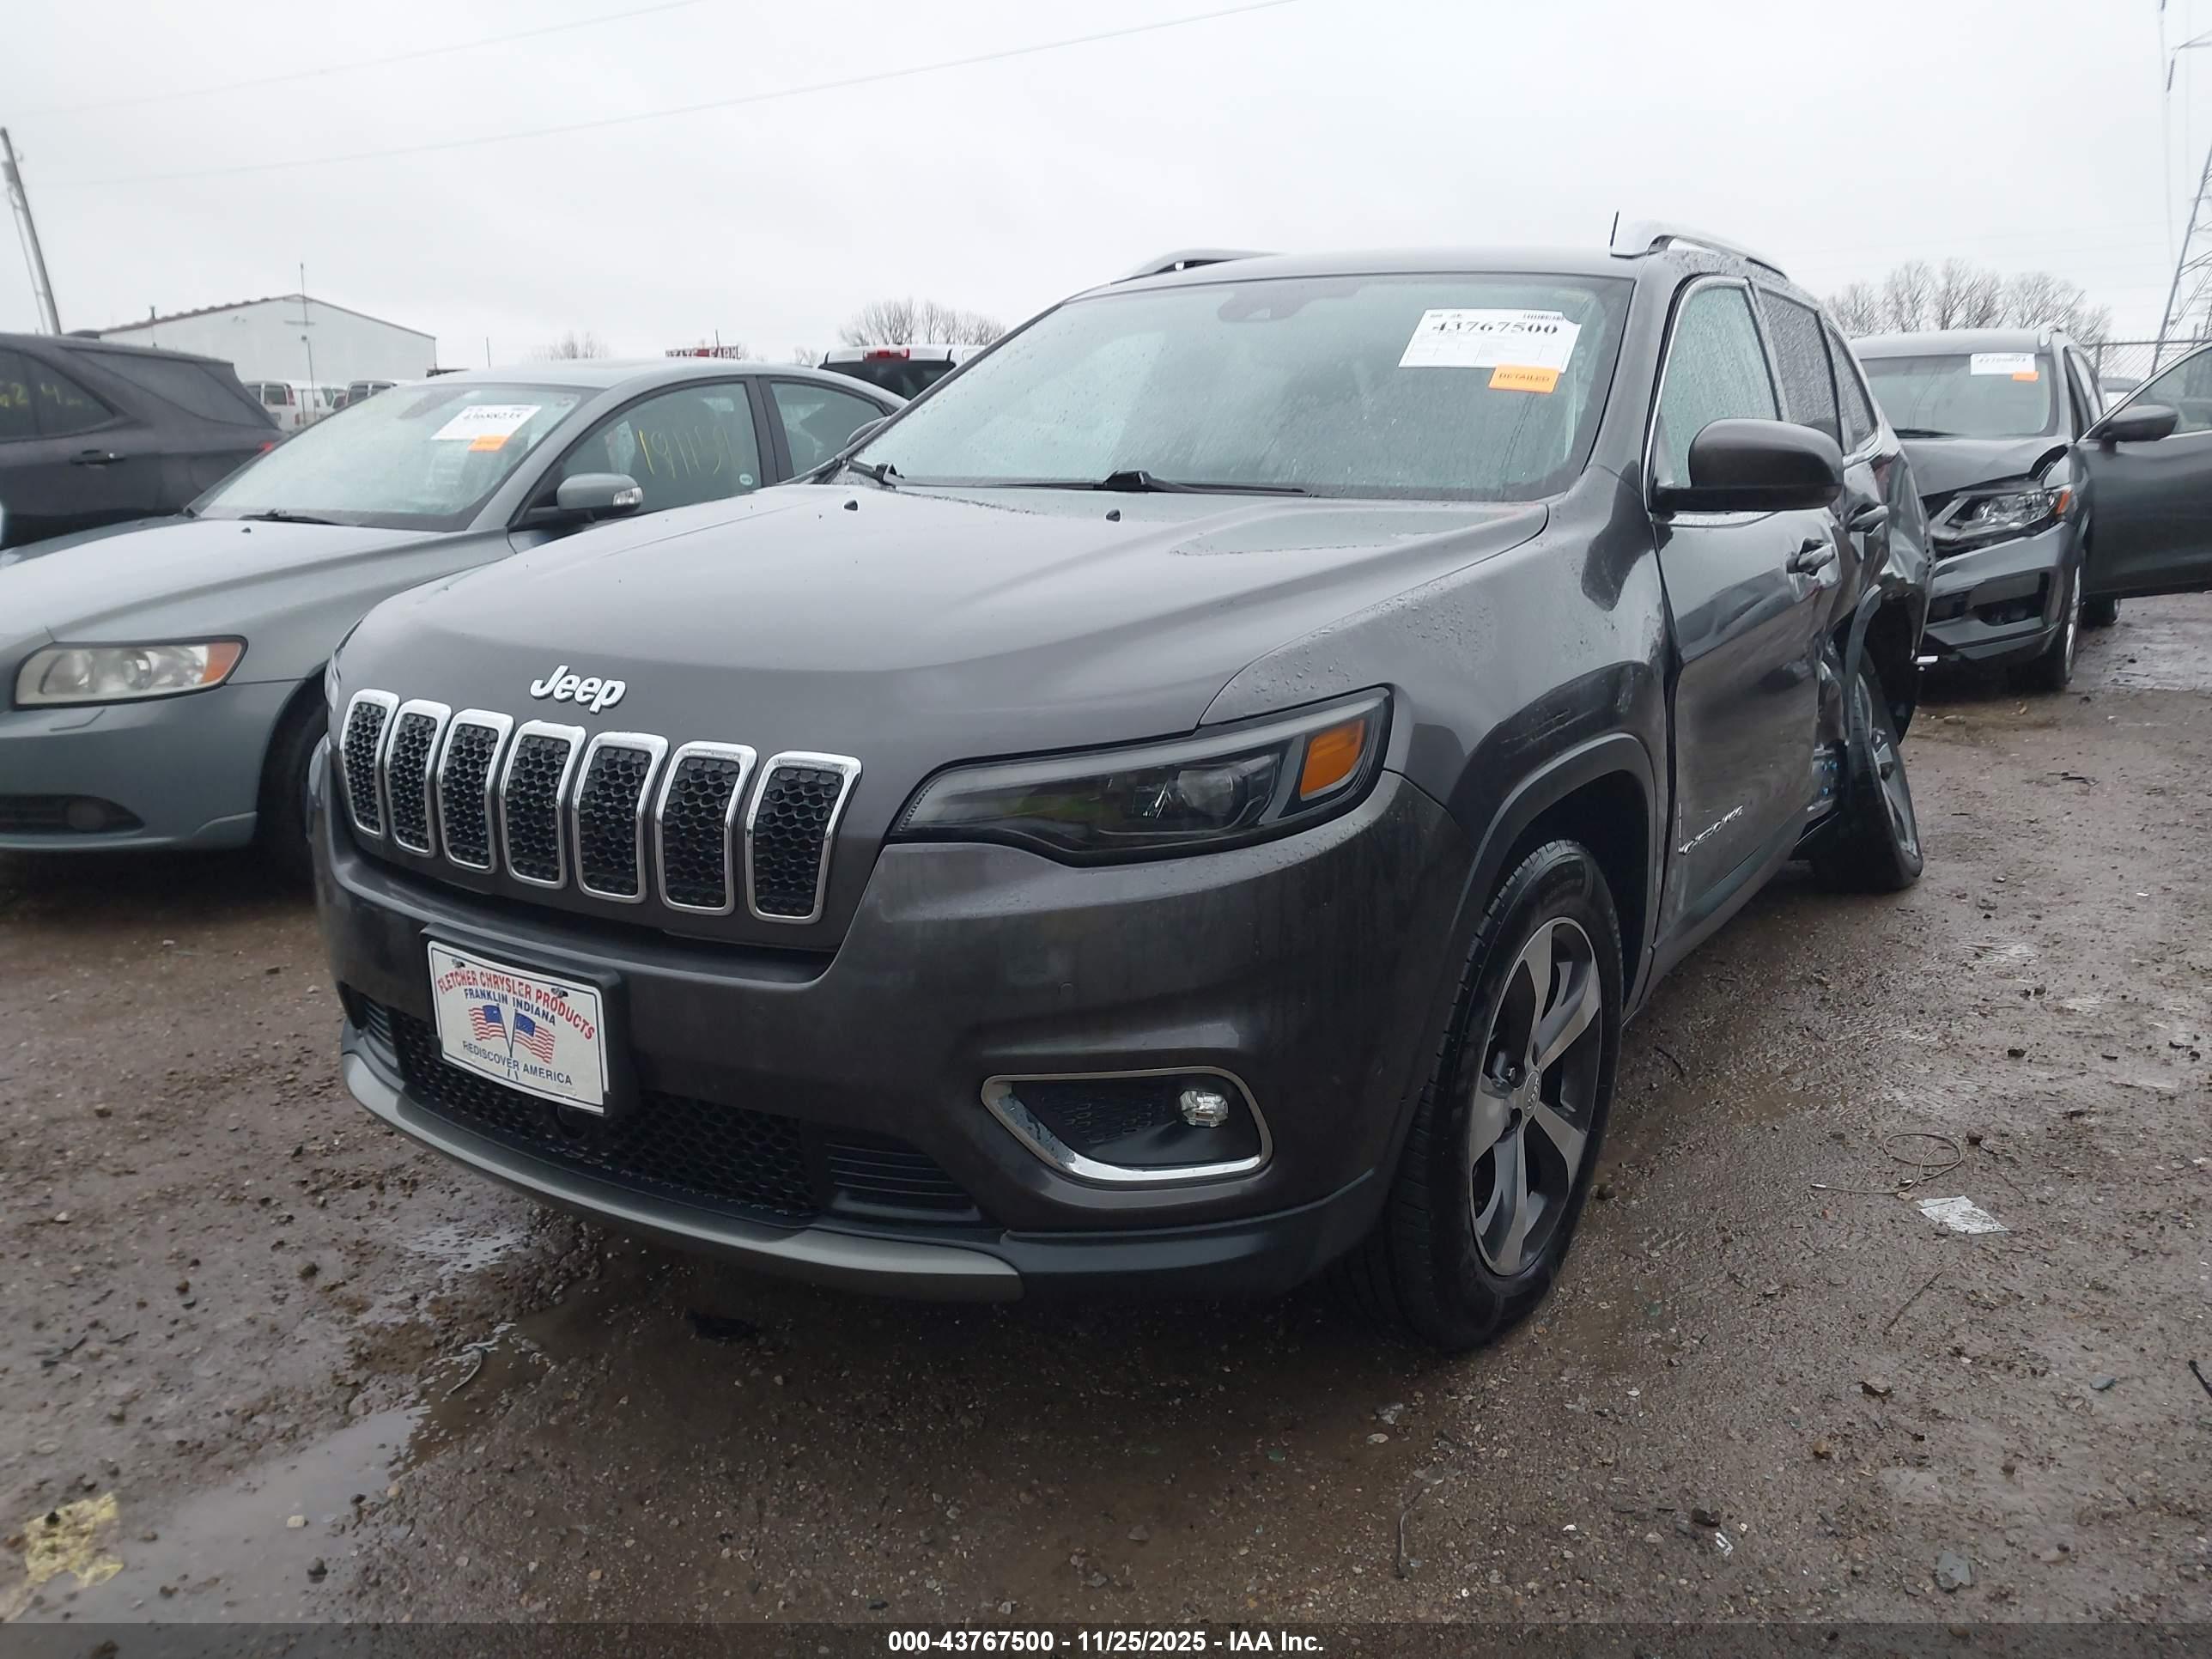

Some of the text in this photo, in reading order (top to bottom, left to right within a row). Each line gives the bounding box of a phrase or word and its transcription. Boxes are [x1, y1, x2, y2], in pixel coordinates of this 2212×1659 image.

[1431, 320, 1559, 336] 43767500
[530, 665, 626, 714] Jeep
[437, 970, 595, 1040] FLETCHER CHRYSLER PRODUCTS
[464, 988, 556, 1026] FRANKLIN INDIANA
[462, 1040, 573, 1085] REDISCOVER AMERICA
